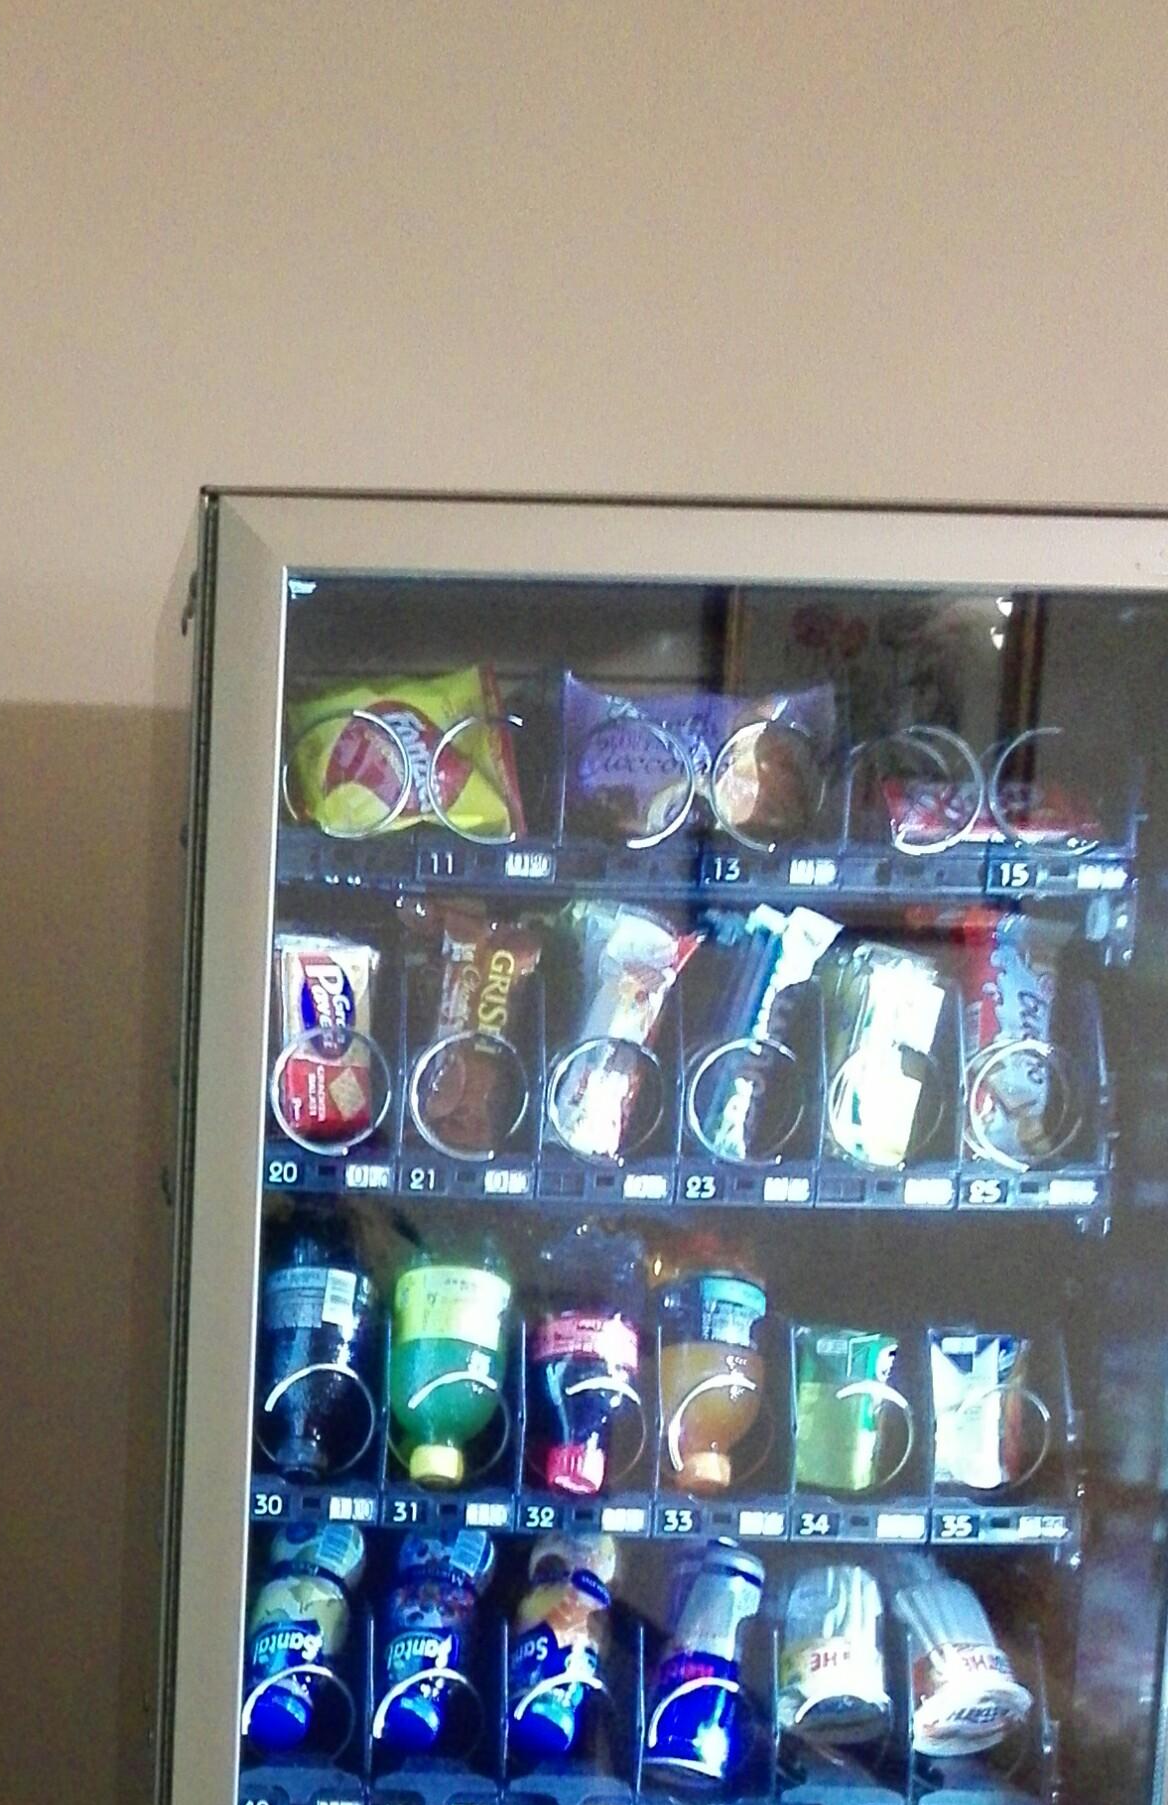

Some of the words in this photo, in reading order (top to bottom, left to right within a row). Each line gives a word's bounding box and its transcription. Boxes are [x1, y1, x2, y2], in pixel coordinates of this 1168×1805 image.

[712, 857, 741, 882] 13
[1000, 863, 1030, 887] 15
[269, 1161, 298, 1183] 20
[409, 1168, 435, 1190] 21
[685, 1176, 716, 1199] 23
[254, 1494, 283, 1516] 30
[394, 1502, 419, 1523] 31
[527, 1506, 555, 1528] 32
[663, 1510, 693, 1533] 33
[799, 1512, 830, 1536] 34
[940, 1514, 972, 1538] 35
